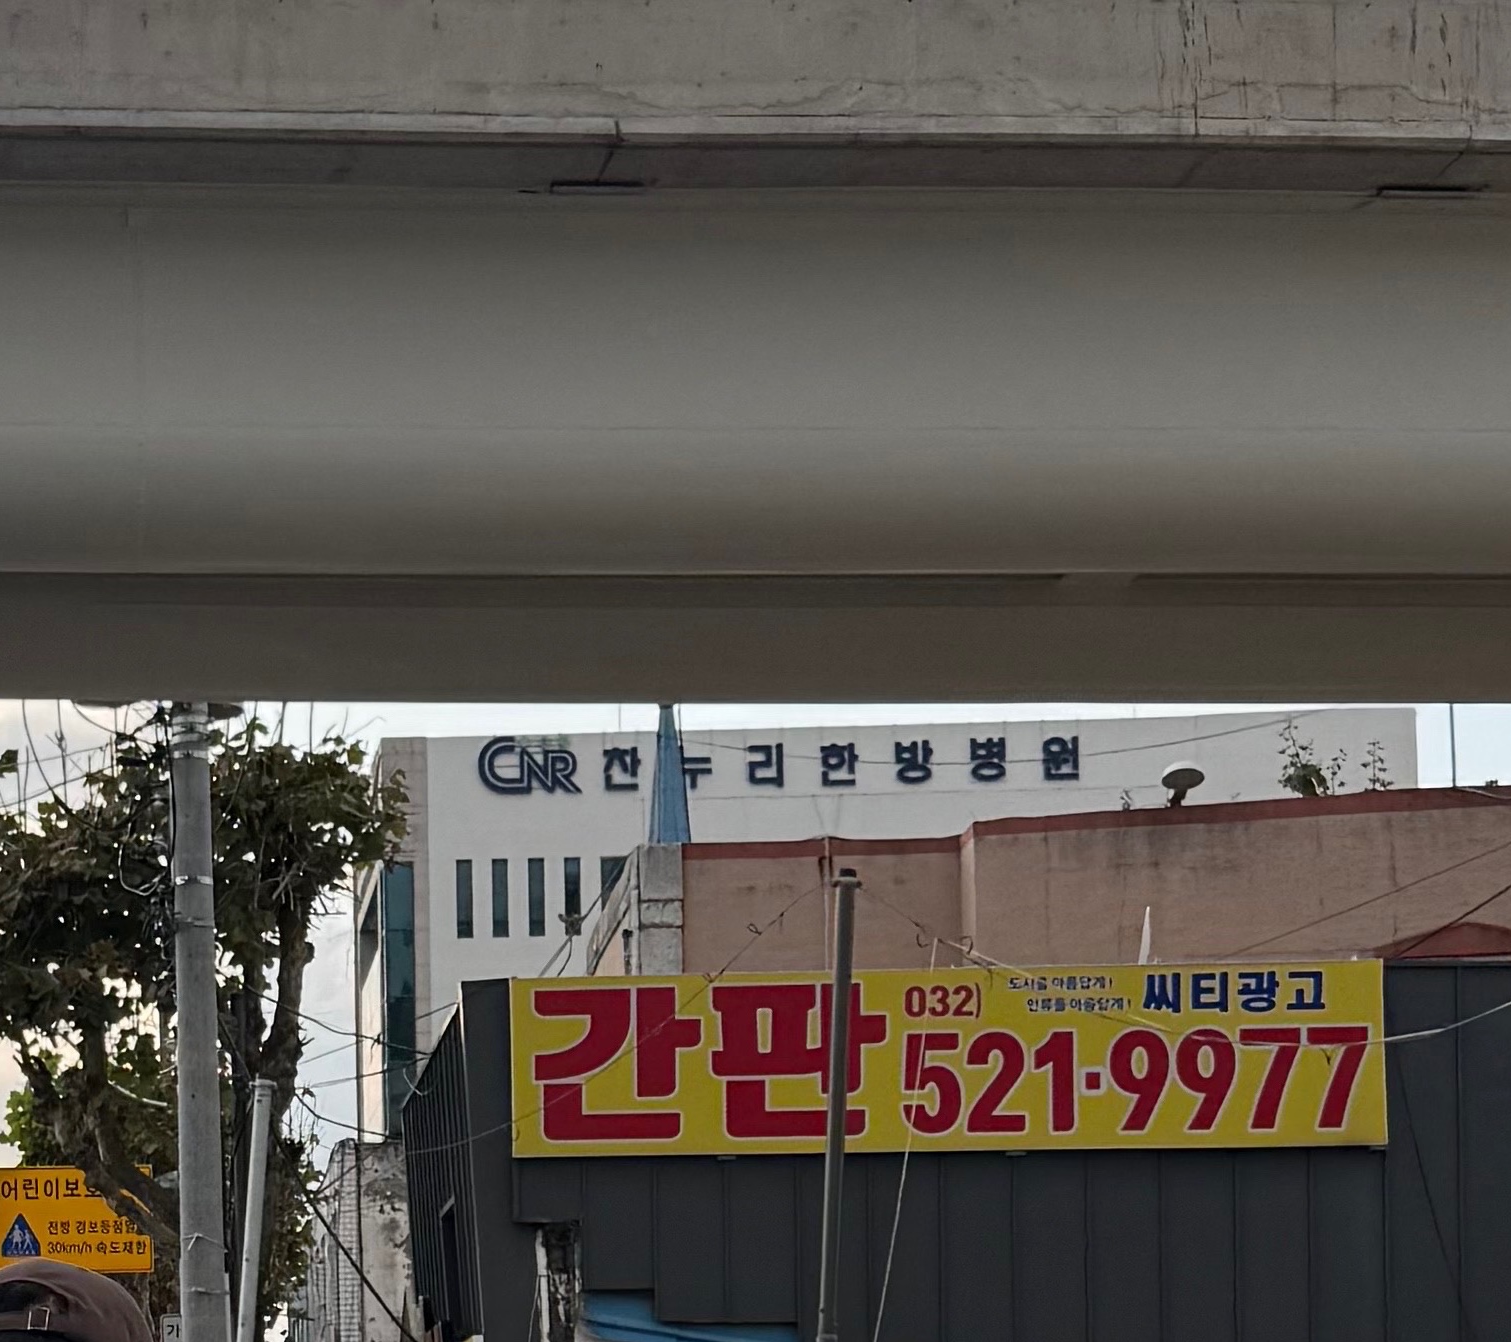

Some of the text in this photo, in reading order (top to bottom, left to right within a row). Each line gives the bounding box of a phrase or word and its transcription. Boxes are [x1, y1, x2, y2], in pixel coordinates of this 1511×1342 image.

[904, 981, 982, 1019] 032)
[1142, 970, 1326, 1013] 씨티광고
[534, 983, 886, 1140] 간판
